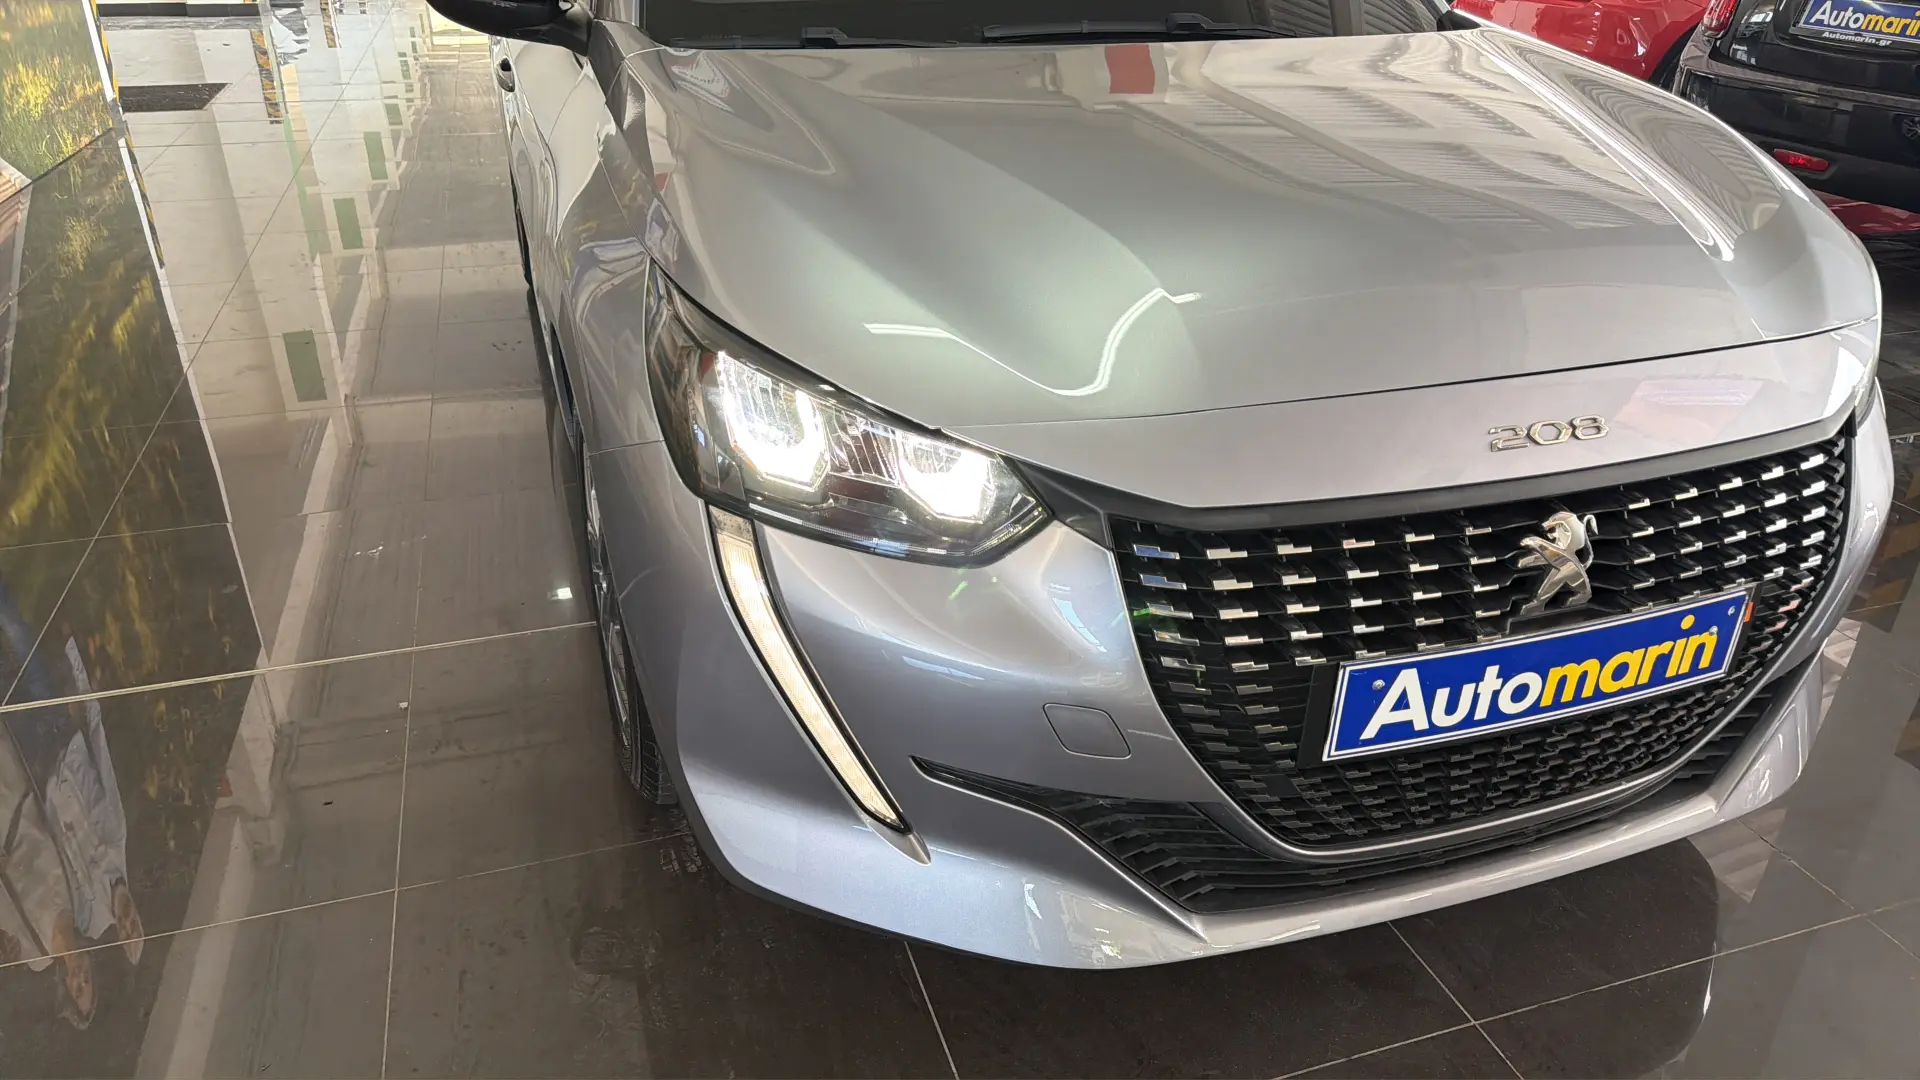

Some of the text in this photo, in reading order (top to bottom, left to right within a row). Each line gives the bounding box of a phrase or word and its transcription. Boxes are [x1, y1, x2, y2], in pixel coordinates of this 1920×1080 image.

[1809, 0, 1920, 37] Automari
[1822, 31, 1893, 46] Automarin.gr
[1488, 414, 1610, 452] 208
[1360, 614, 1718, 740] Automarin
